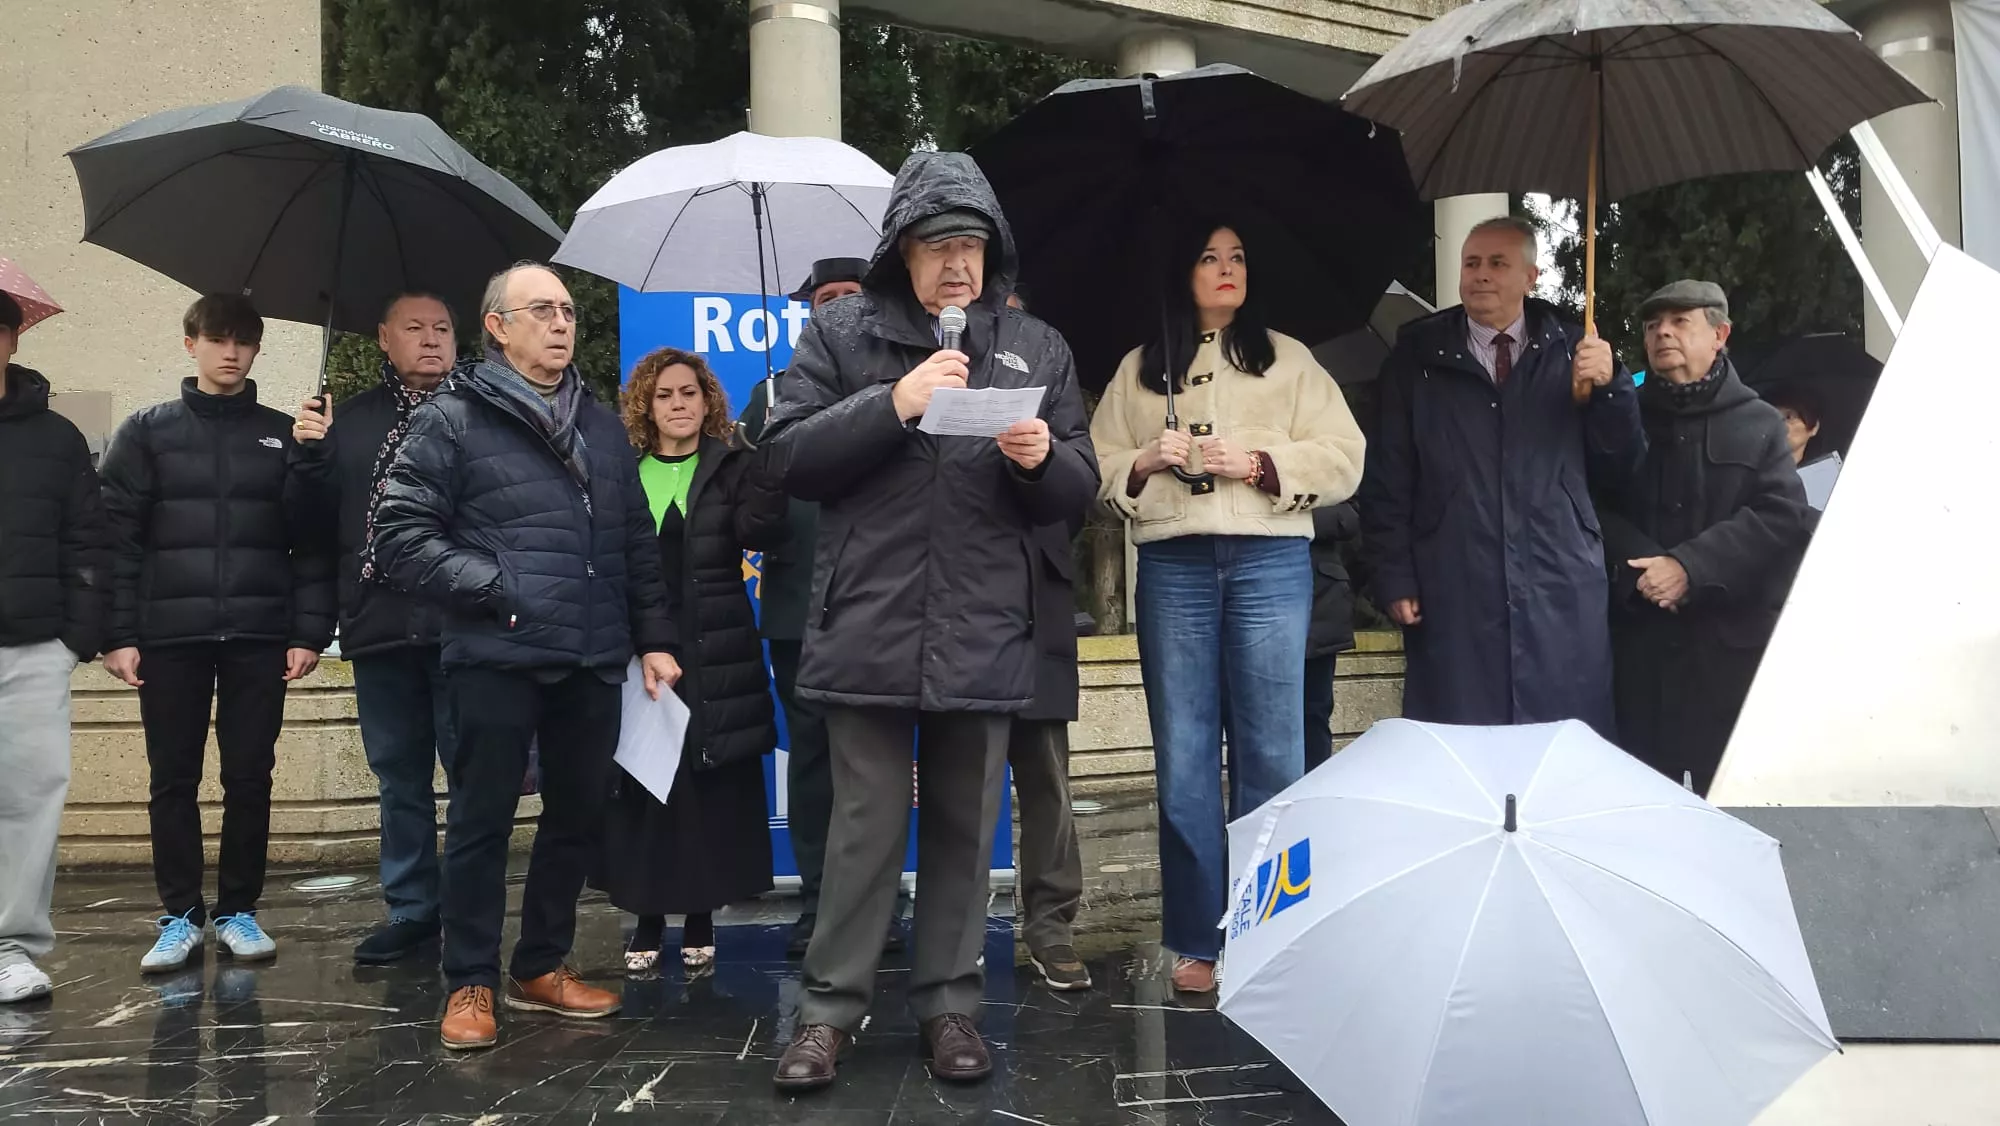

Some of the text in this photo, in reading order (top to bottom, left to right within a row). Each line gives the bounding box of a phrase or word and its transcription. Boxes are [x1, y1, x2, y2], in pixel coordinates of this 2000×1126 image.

[309, 120, 381, 141] Automóviles
[318, 128, 395, 151] CABRERO
[693, 296, 810, 353] Rot
[1240, 882, 1252, 935] EALE
